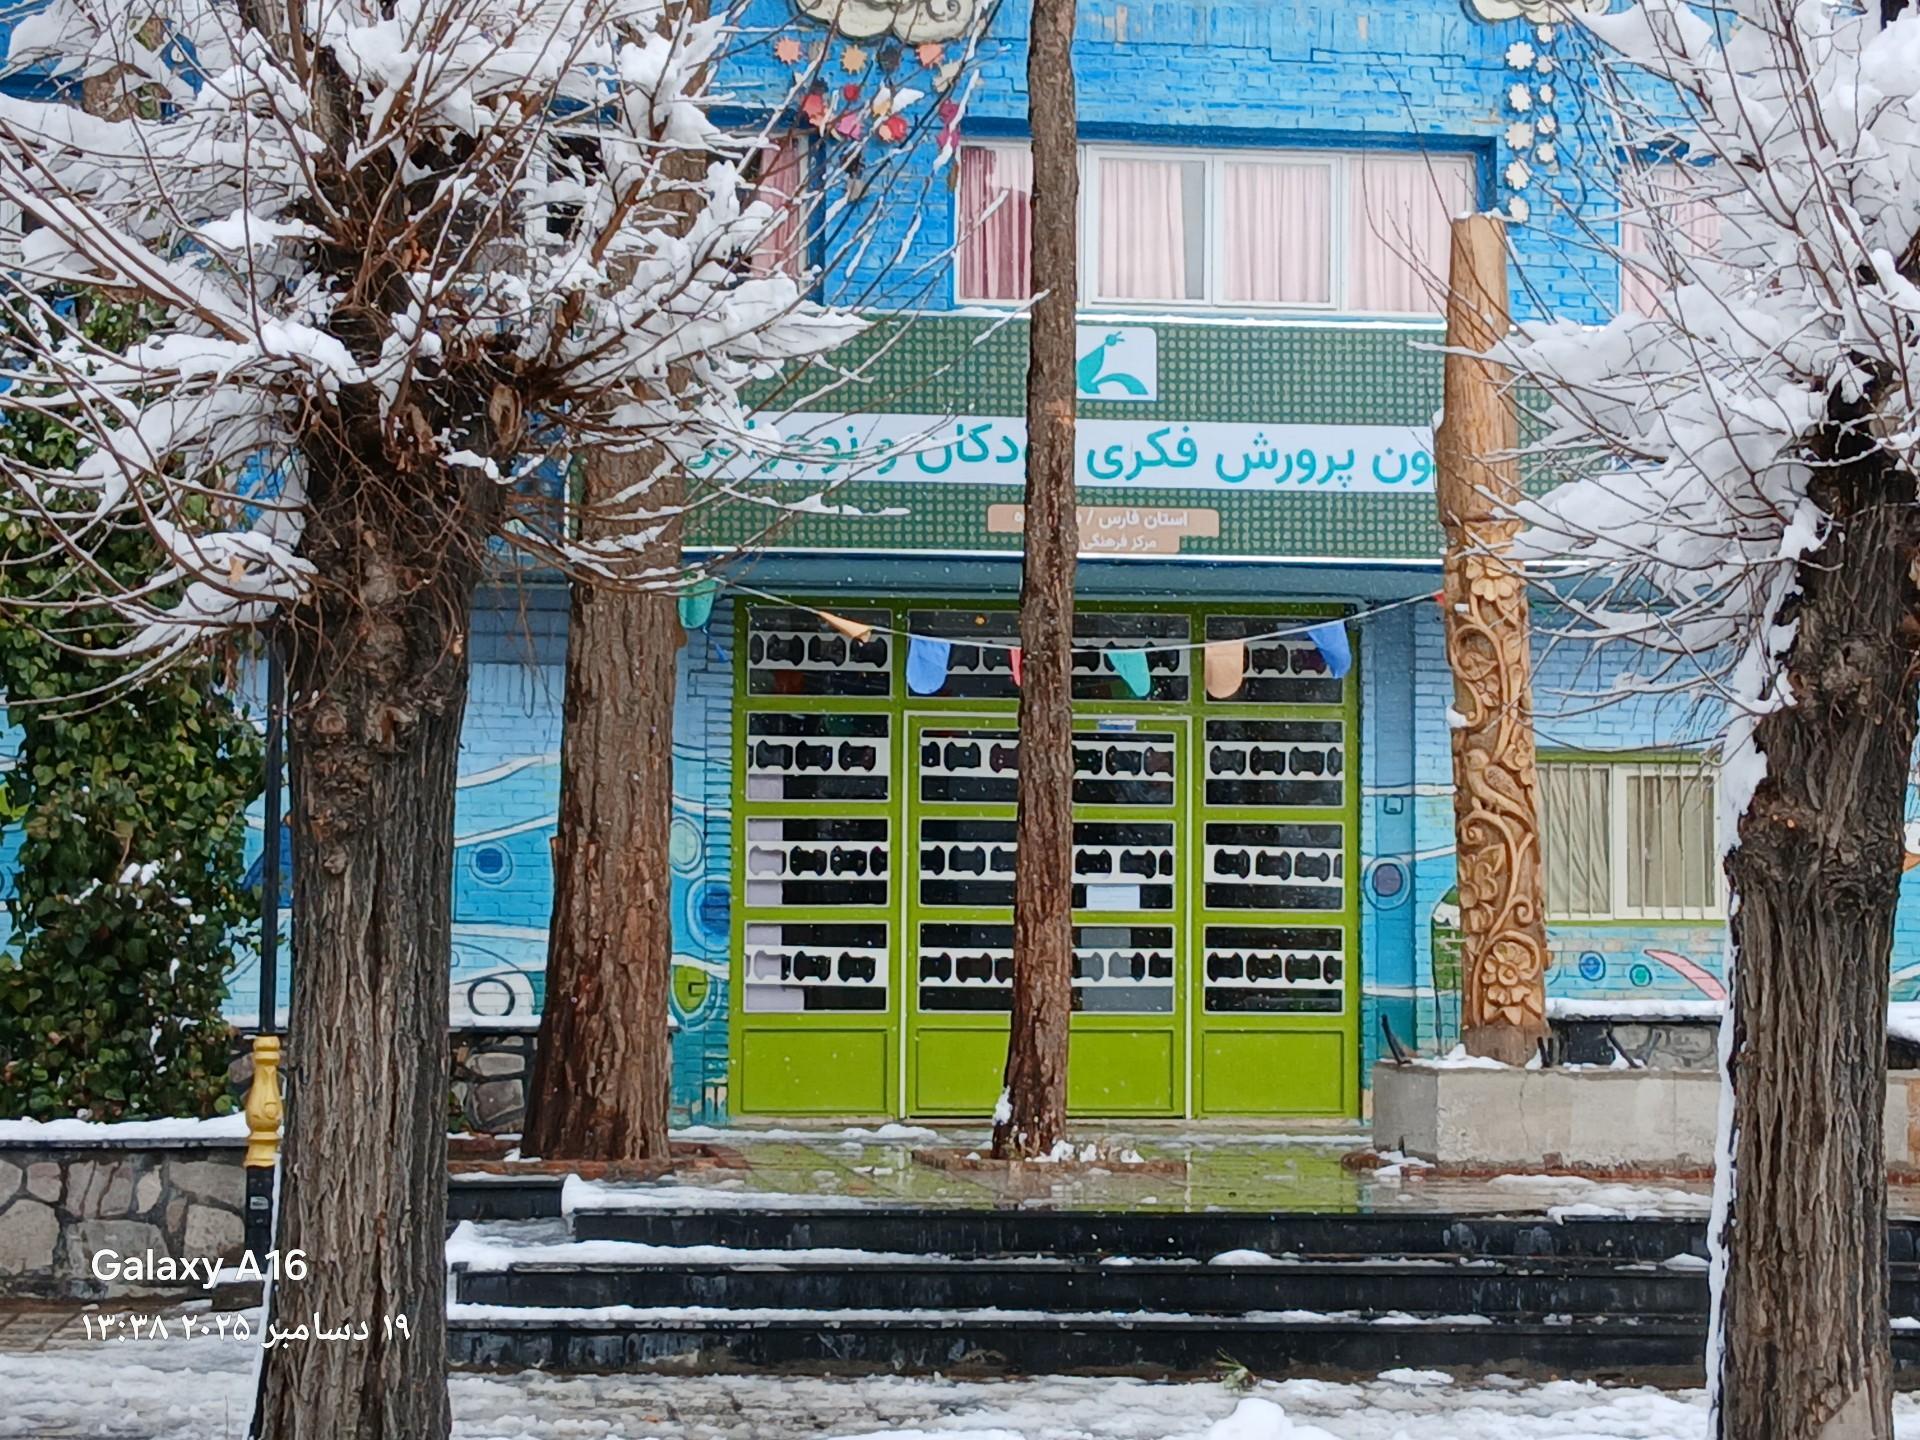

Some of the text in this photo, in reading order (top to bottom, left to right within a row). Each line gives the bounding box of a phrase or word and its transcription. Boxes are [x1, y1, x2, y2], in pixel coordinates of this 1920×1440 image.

[915, 423, 1028, 474] دکان
[1087, 425, 1198, 481] فکری
[1216, 432, 1355, 488] پرورش
[1099, 510, 1139, 528] فارس
[1144, 510, 1188, 527] استان
[1080, 533, 1157, 552] مرکز فرهنگی
